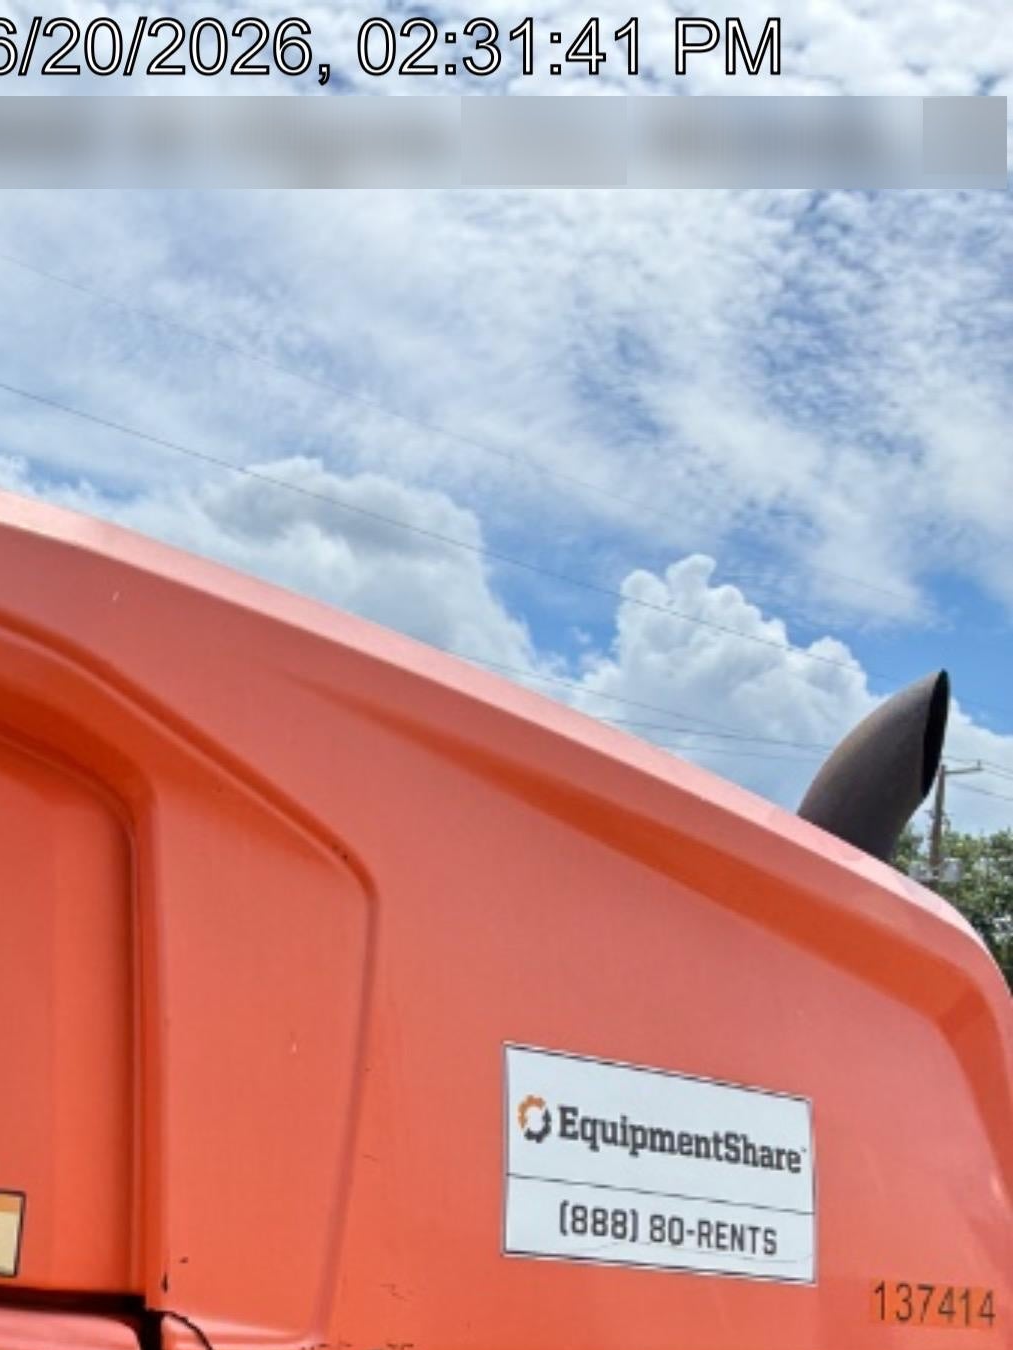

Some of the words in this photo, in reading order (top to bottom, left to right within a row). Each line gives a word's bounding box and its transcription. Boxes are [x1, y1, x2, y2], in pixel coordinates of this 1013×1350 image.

[558, 1104, 802, 1174] EquipmentShare
[559, 1200, 639, 1243] (888)
[649, 1214, 778, 1256] 80-RENTS
[874, 1281, 997, 1326] 137414
